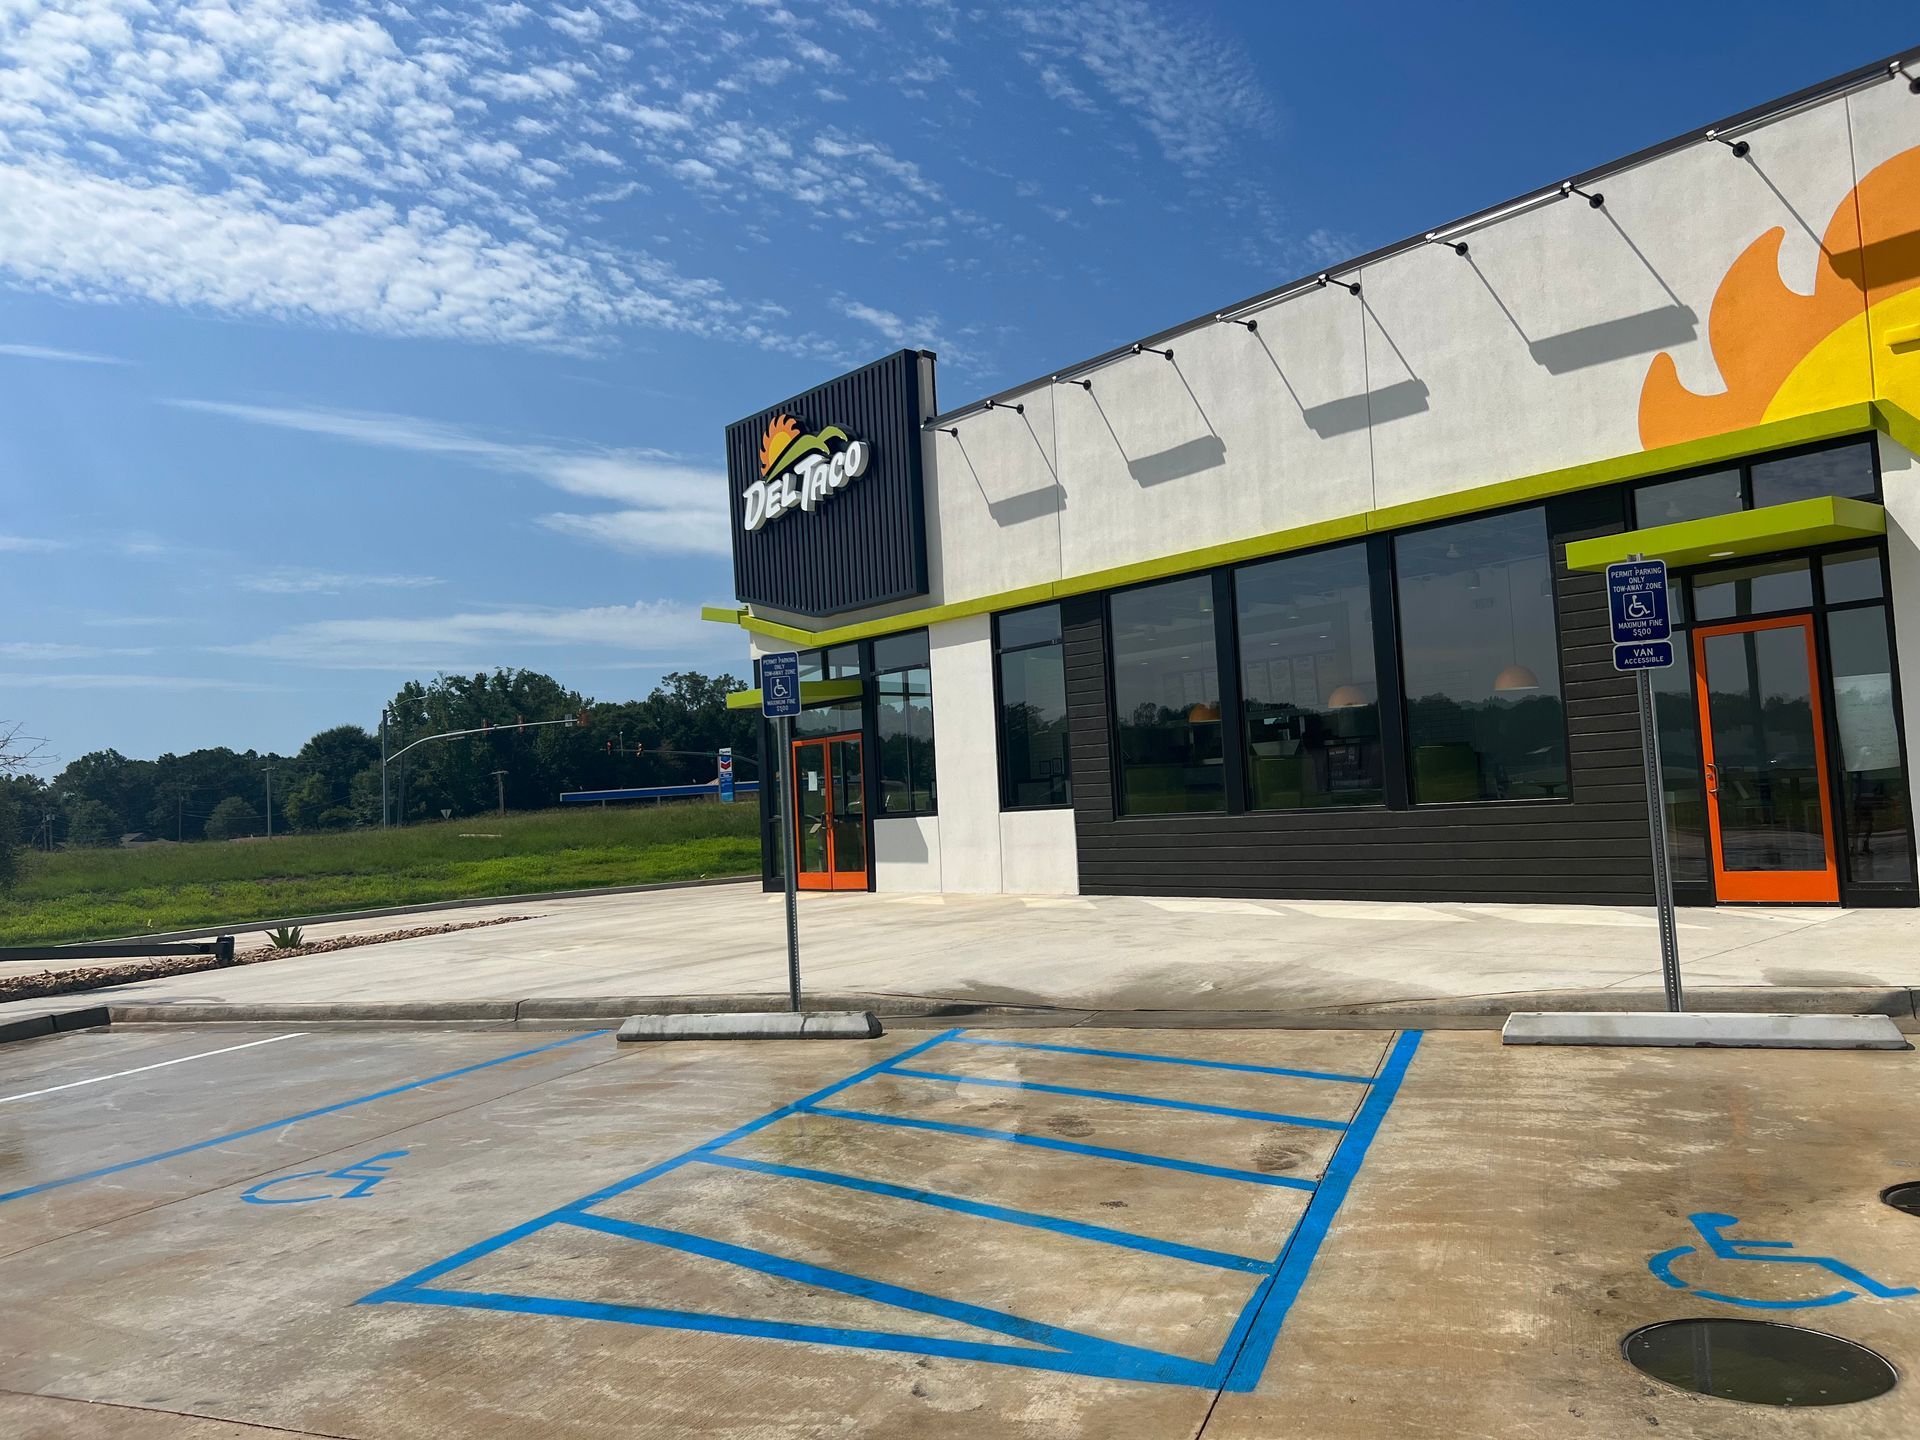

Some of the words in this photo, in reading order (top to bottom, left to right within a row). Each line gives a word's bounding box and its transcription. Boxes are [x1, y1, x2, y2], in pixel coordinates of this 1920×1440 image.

[743, 473, 799, 530] DEL
[794, 441, 866, 511] TACO
[1611, 570, 1632, 578] PERMIT
[1635, 567, 1662, 575] PARKING
[1613, 584, 1643, 592] TOW-AWAY
[1618, 621, 1647, 629] MAXIMUM
[1633, 628, 1652, 636] $500
[1633, 648, 1654, 657] VAN
[1624, 656, 1664, 664] ACCESSIBLE
